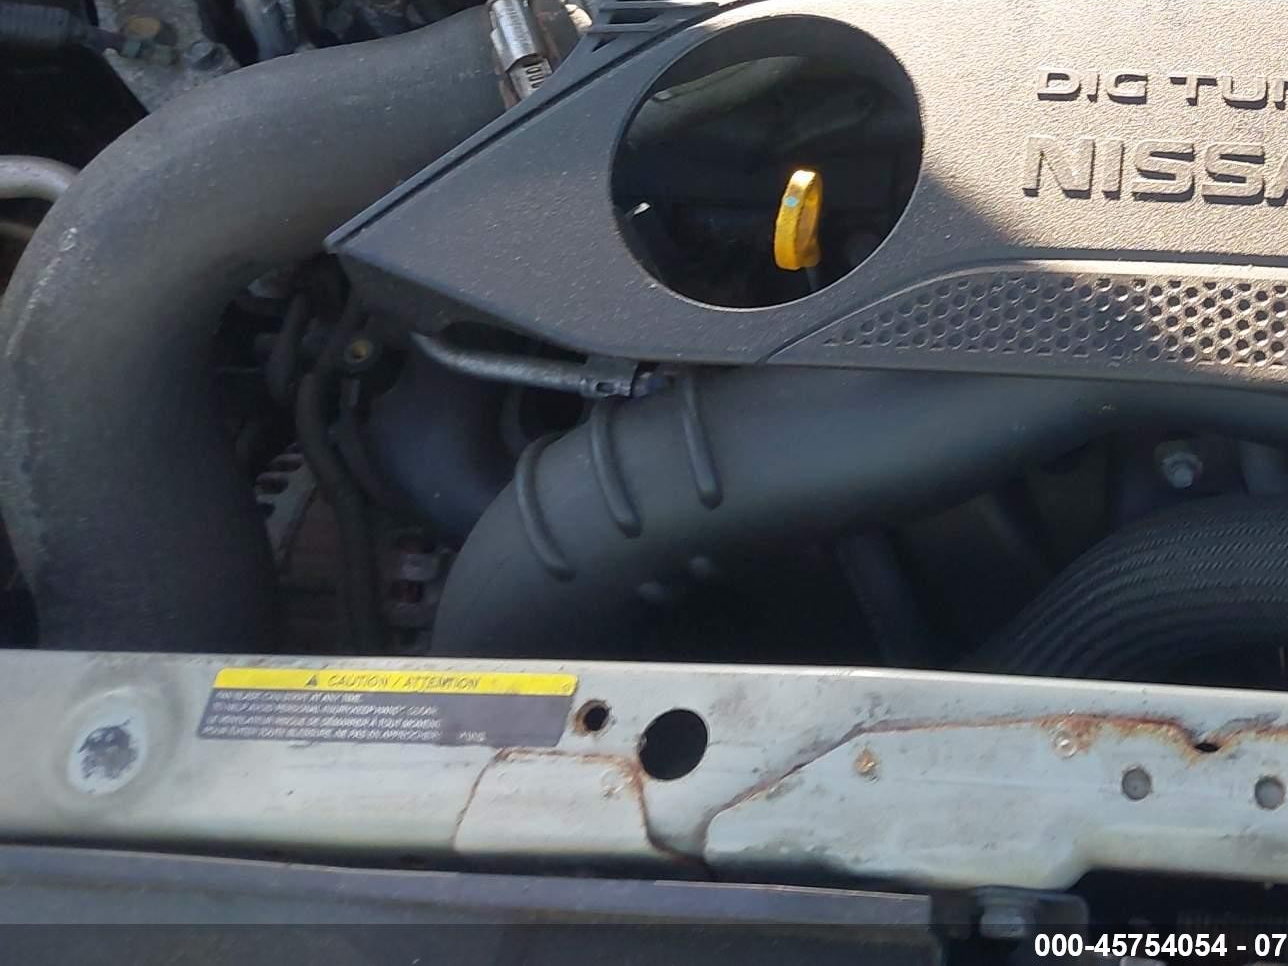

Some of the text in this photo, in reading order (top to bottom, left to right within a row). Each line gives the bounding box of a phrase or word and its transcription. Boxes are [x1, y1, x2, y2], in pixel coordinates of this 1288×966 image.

[1036, 67, 1149, 104] DIG
[327, 674, 390, 688] CAUTION
[403, 675, 482, 691] ATTENTION
